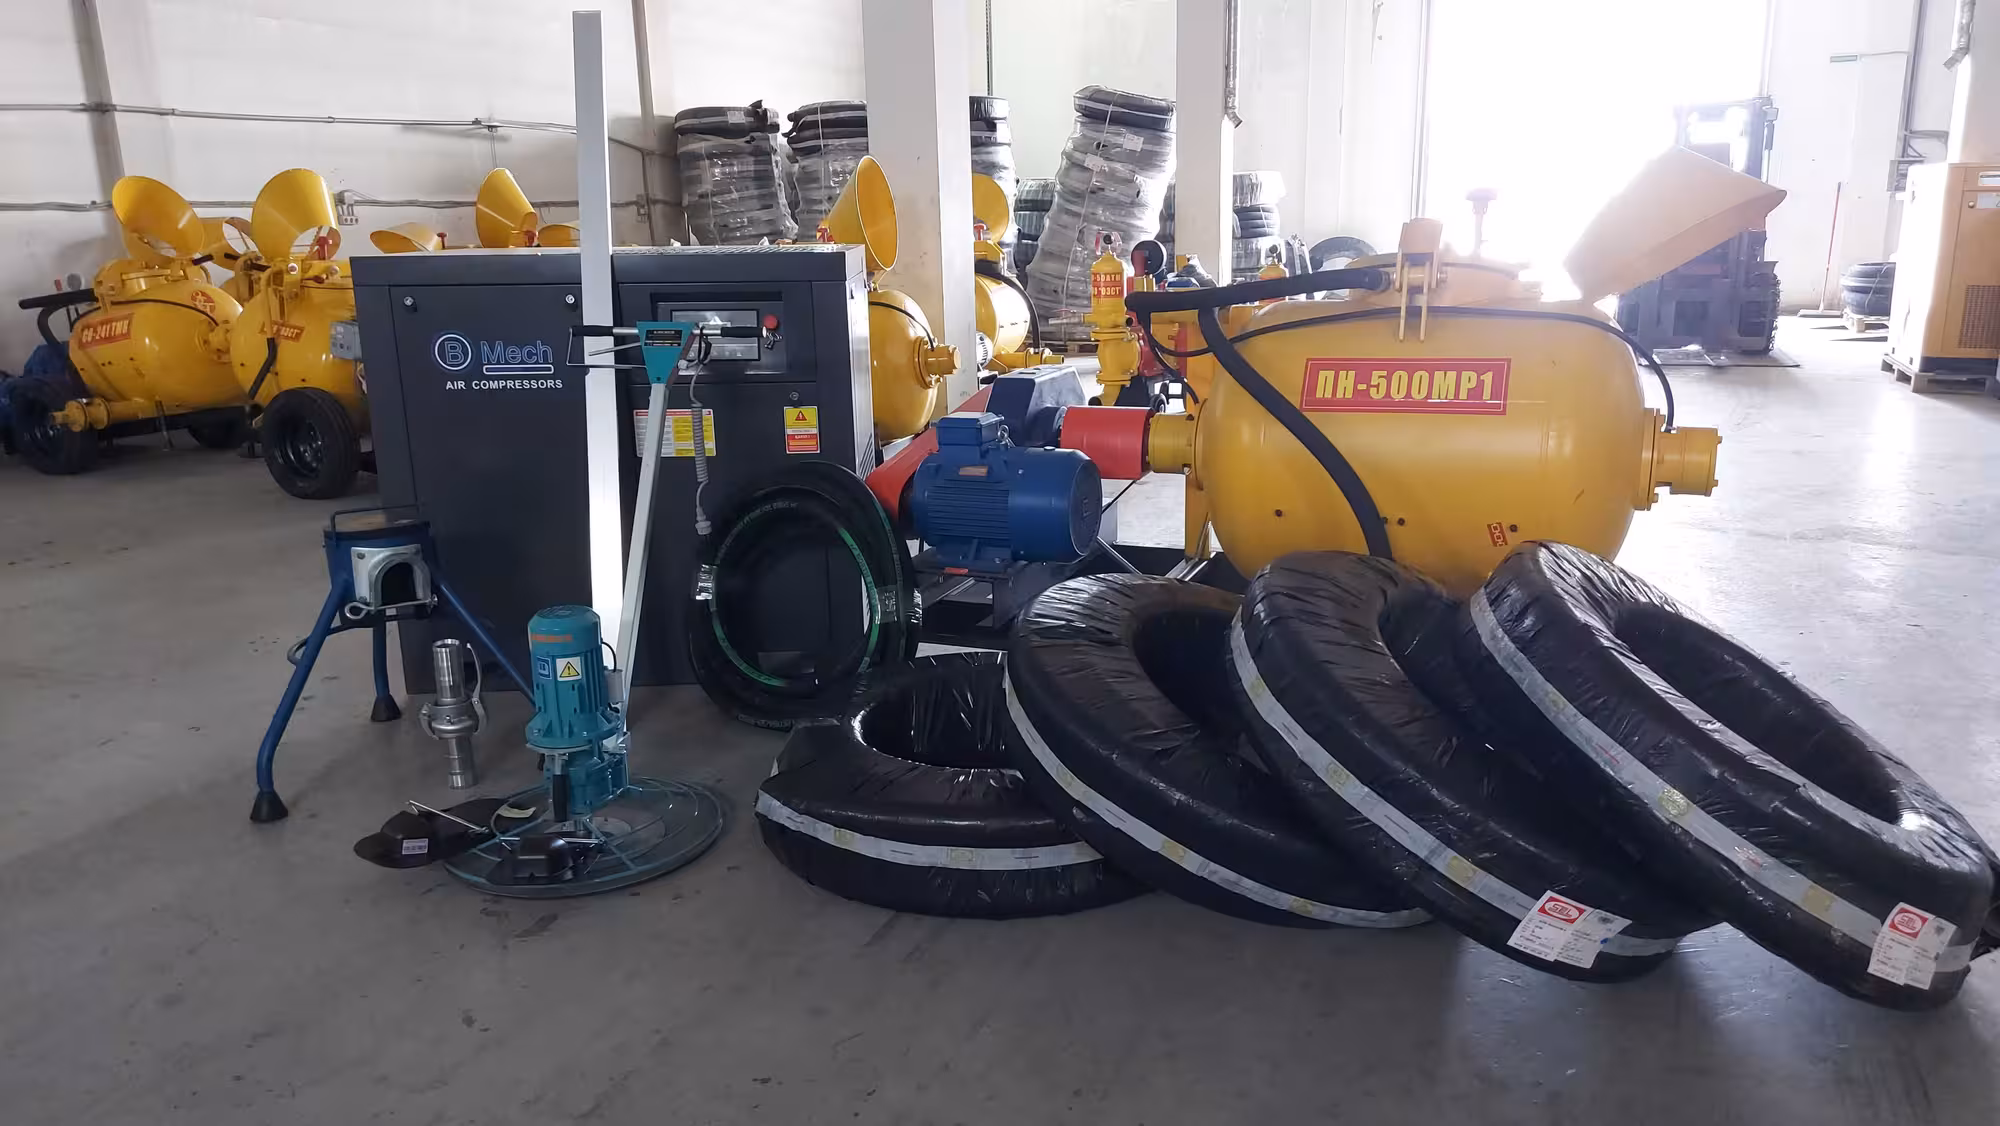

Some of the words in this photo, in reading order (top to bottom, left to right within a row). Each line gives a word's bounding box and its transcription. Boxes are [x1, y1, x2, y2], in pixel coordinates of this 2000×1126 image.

[480, 340, 553, 364] Mech
[445, 380, 467, 390] AIR
[472, 379, 563, 390] COMPRESSORS
[1315, 370, 1494, 400] ПН-500МР1
